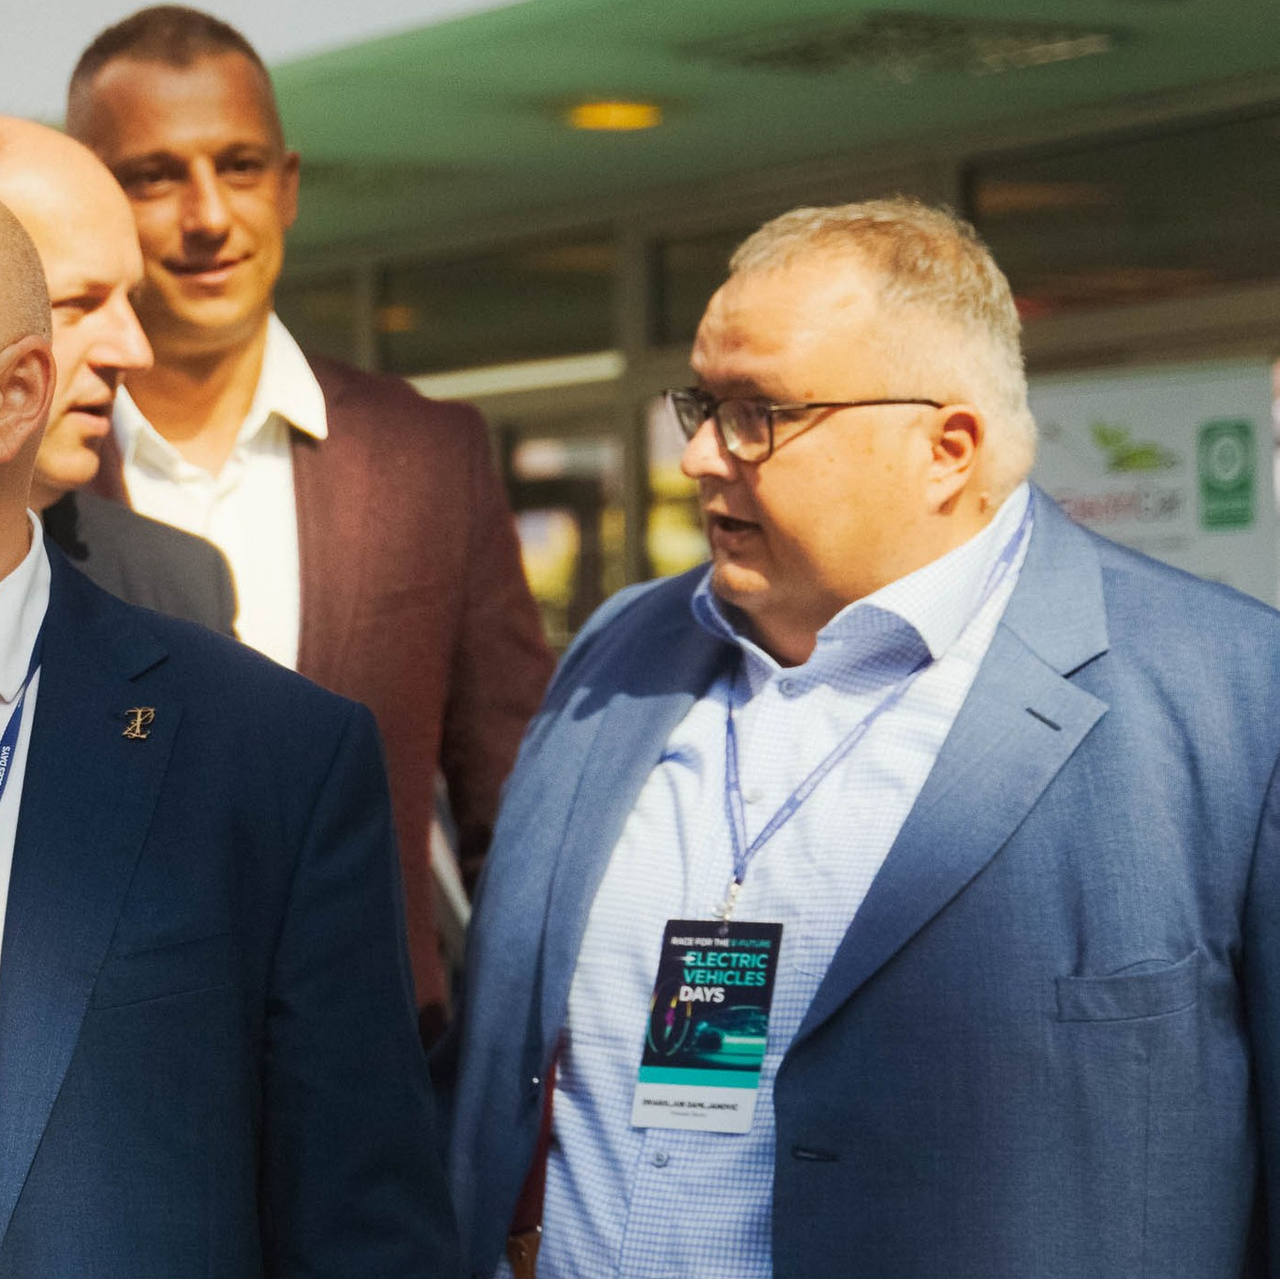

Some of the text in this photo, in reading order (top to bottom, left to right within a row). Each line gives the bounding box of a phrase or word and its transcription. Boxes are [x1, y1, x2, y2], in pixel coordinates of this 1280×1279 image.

[0, 745, 11, 767] DAYS
[684, 950, 769, 969] ELECTRIC
[682, 968, 767, 987] VEHICLES
[679, 985, 726, 1003] DAYS
